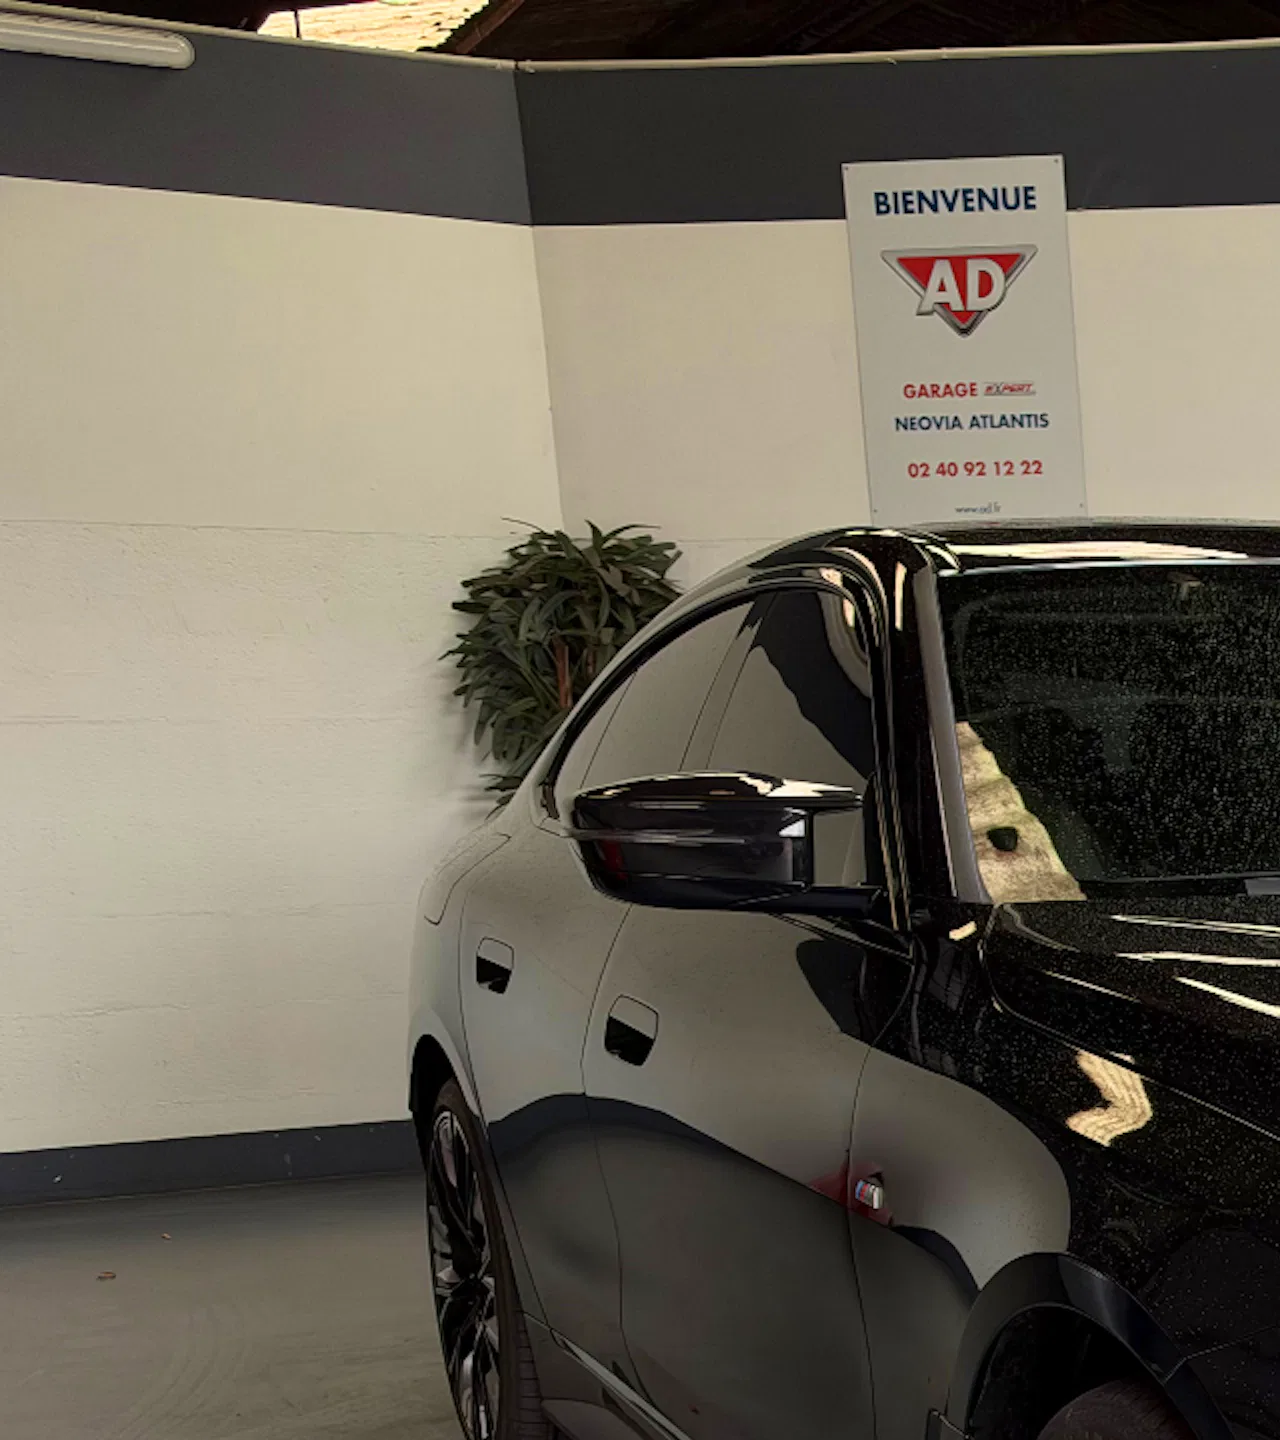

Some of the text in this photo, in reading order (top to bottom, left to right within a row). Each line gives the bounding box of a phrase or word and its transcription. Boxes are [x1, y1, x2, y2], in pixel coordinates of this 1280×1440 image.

[873, 185, 1037, 216] BIENVENUE
[916, 257, 1007, 316] AD
[903, 382, 978, 399] GARAGE
[894, 413, 1050, 431] NEOVIA ATLANTIS
[907, 459, 1043, 478] 02 40 92 12 22
